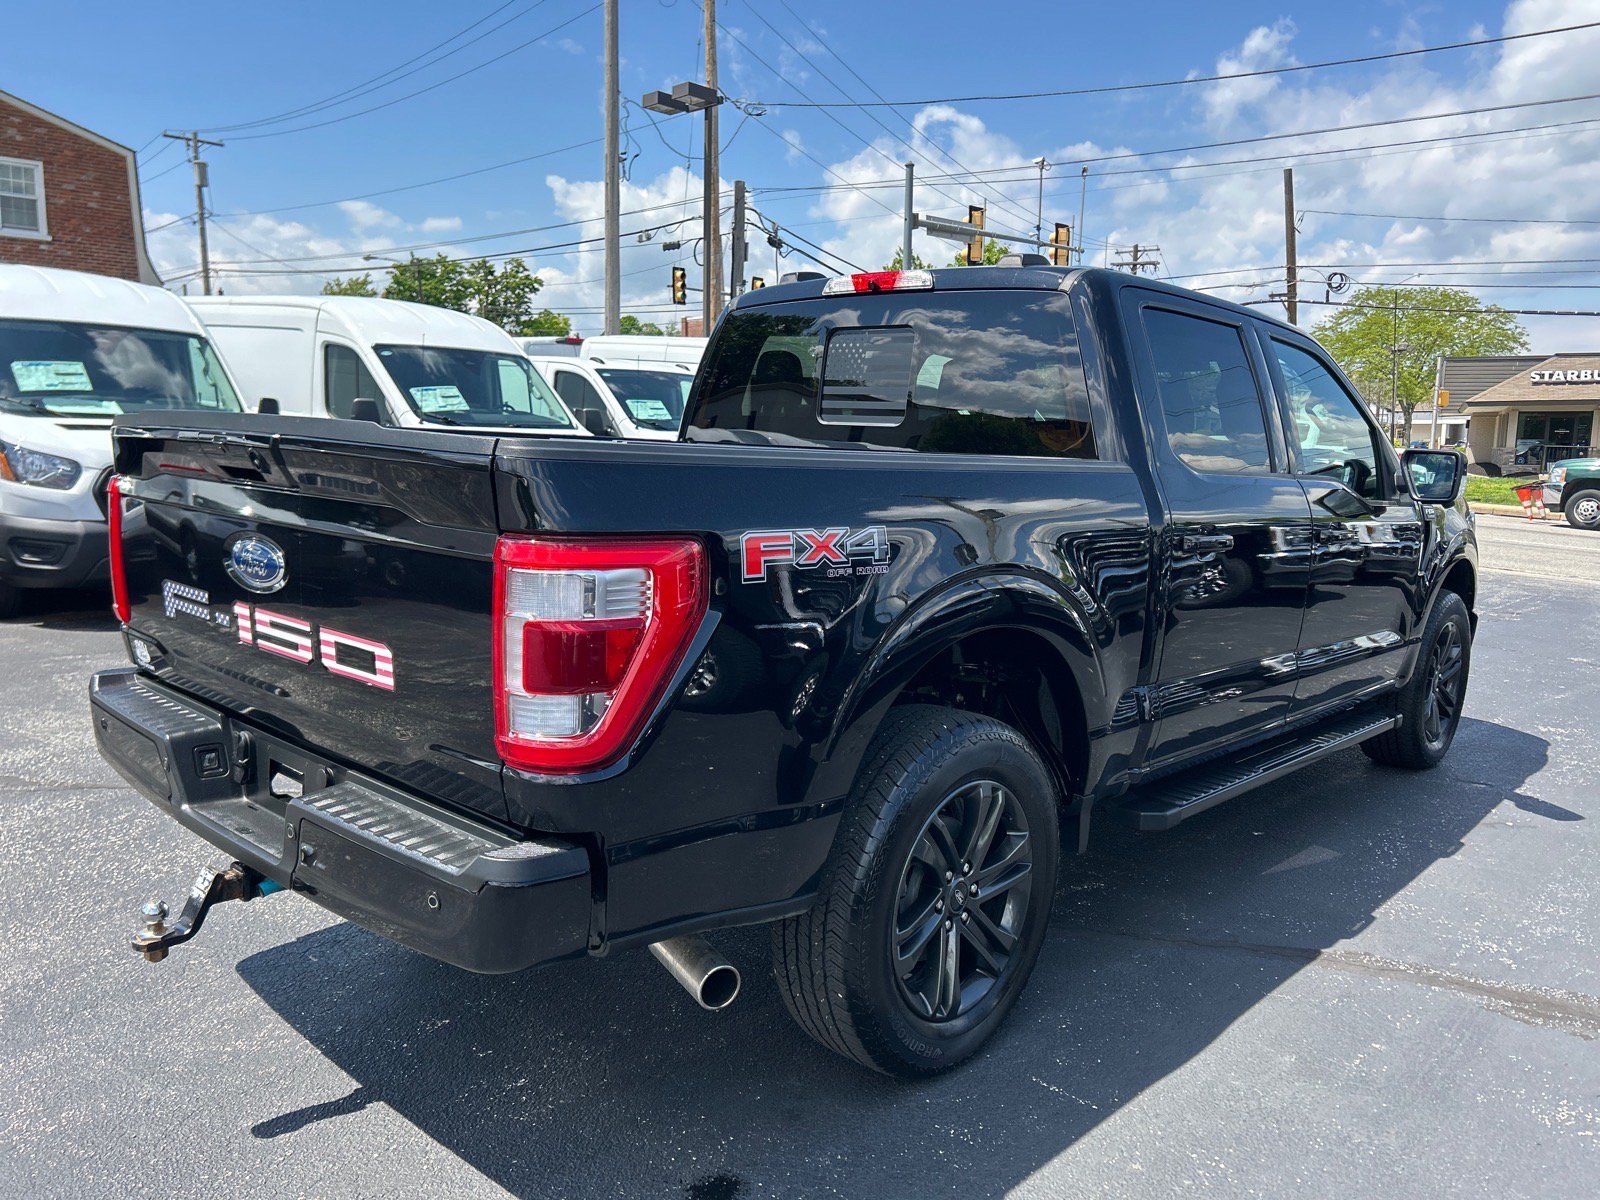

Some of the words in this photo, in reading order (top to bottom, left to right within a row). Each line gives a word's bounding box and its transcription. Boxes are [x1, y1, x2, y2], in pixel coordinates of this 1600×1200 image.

[237, 546, 268, 577] Ford
[740, 526, 890, 584] FX4
[827, 569, 853, 578] OFF
[856, 566, 890, 576] ROAD
[161, 578, 395, 692] F-150
